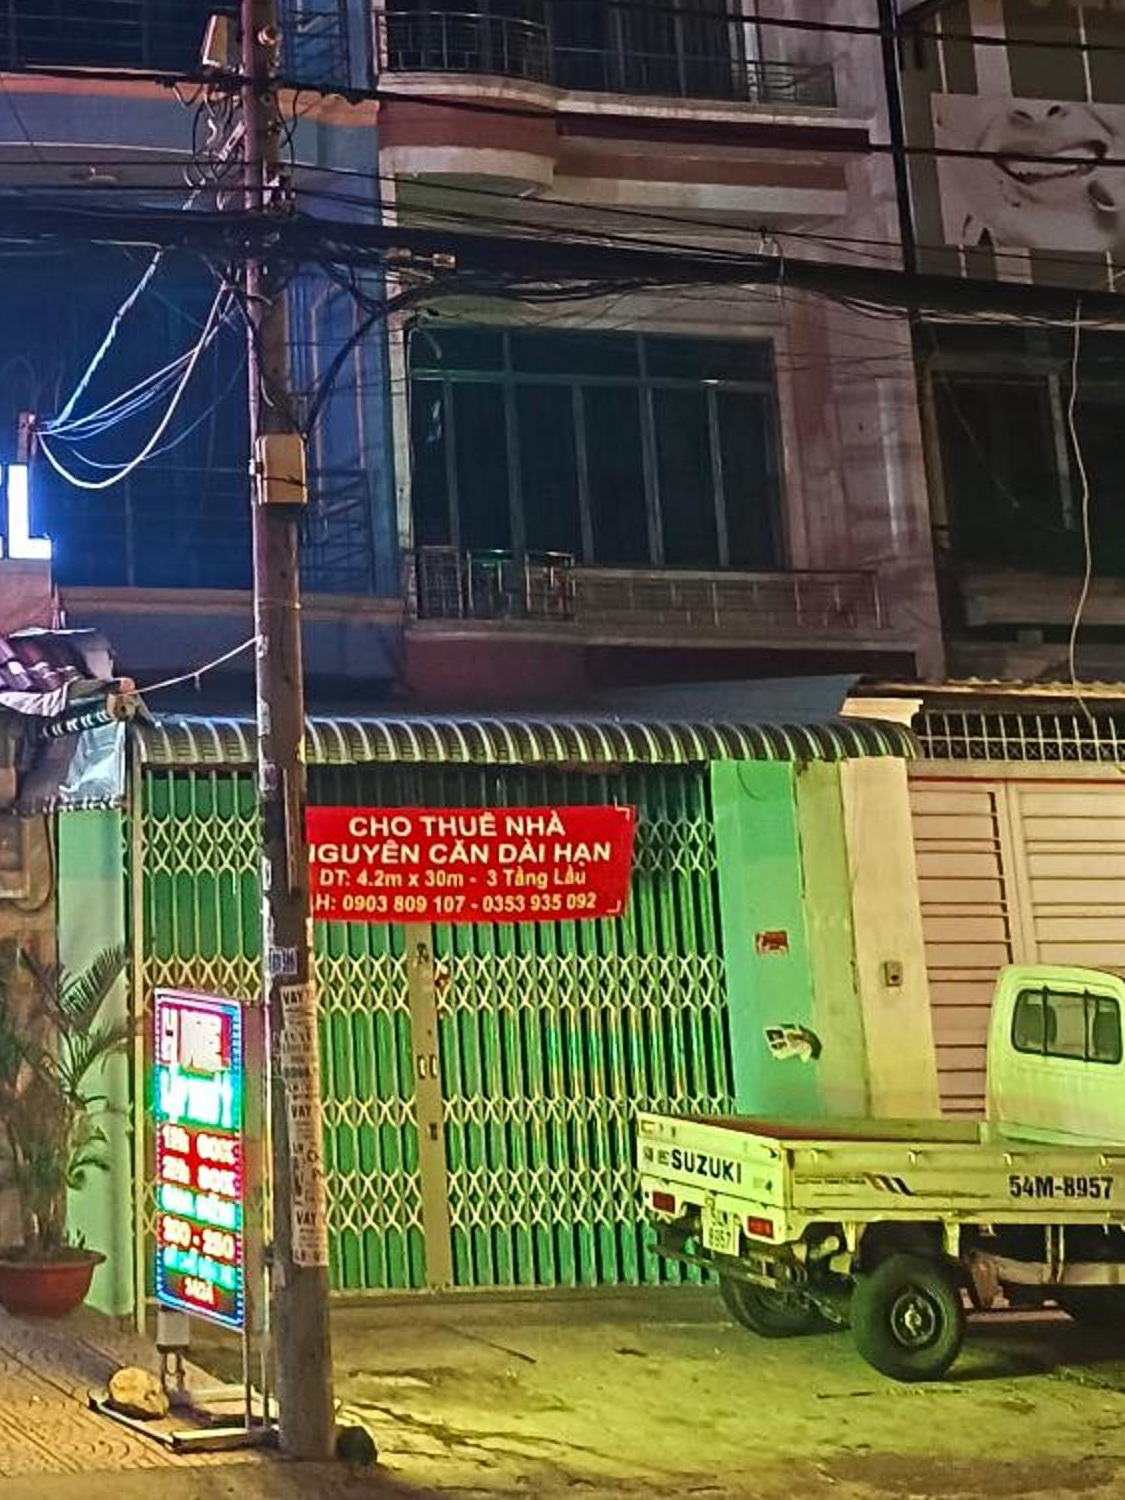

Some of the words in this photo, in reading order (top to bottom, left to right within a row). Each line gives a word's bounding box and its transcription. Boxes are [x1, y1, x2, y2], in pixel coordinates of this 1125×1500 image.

[349, 815, 412, 837] CHO
[419, 811, 498, 837] THUÊ
[505, 809, 566, 837] NHÀ
[429, 838, 490, 864] CĂN
[498, 838, 546, 864] DÀI
[554, 841, 612, 867] HẠN
[320, 868, 351, 887] DT:
[356, 868, 403, 888] 4.2m
[408, 872, 420, 888] x
[425, 868, 465, 888] 30m
[486, 868, 498, 887] 3
[342, 894, 388, 912] 0903
[394, 895, 428, 913] 809
[433, 895, 466, 913] 107
[482, 894, 526, 913] 0353
[530, 893, 562, 912] 935
[566, 891, 597, 911] 092
[671, 1148, 742, 1185] SUZUKI
[1008, 1175, 1114, 1199] 54M-8957
[296, 1211, 317, 1226] VAY
